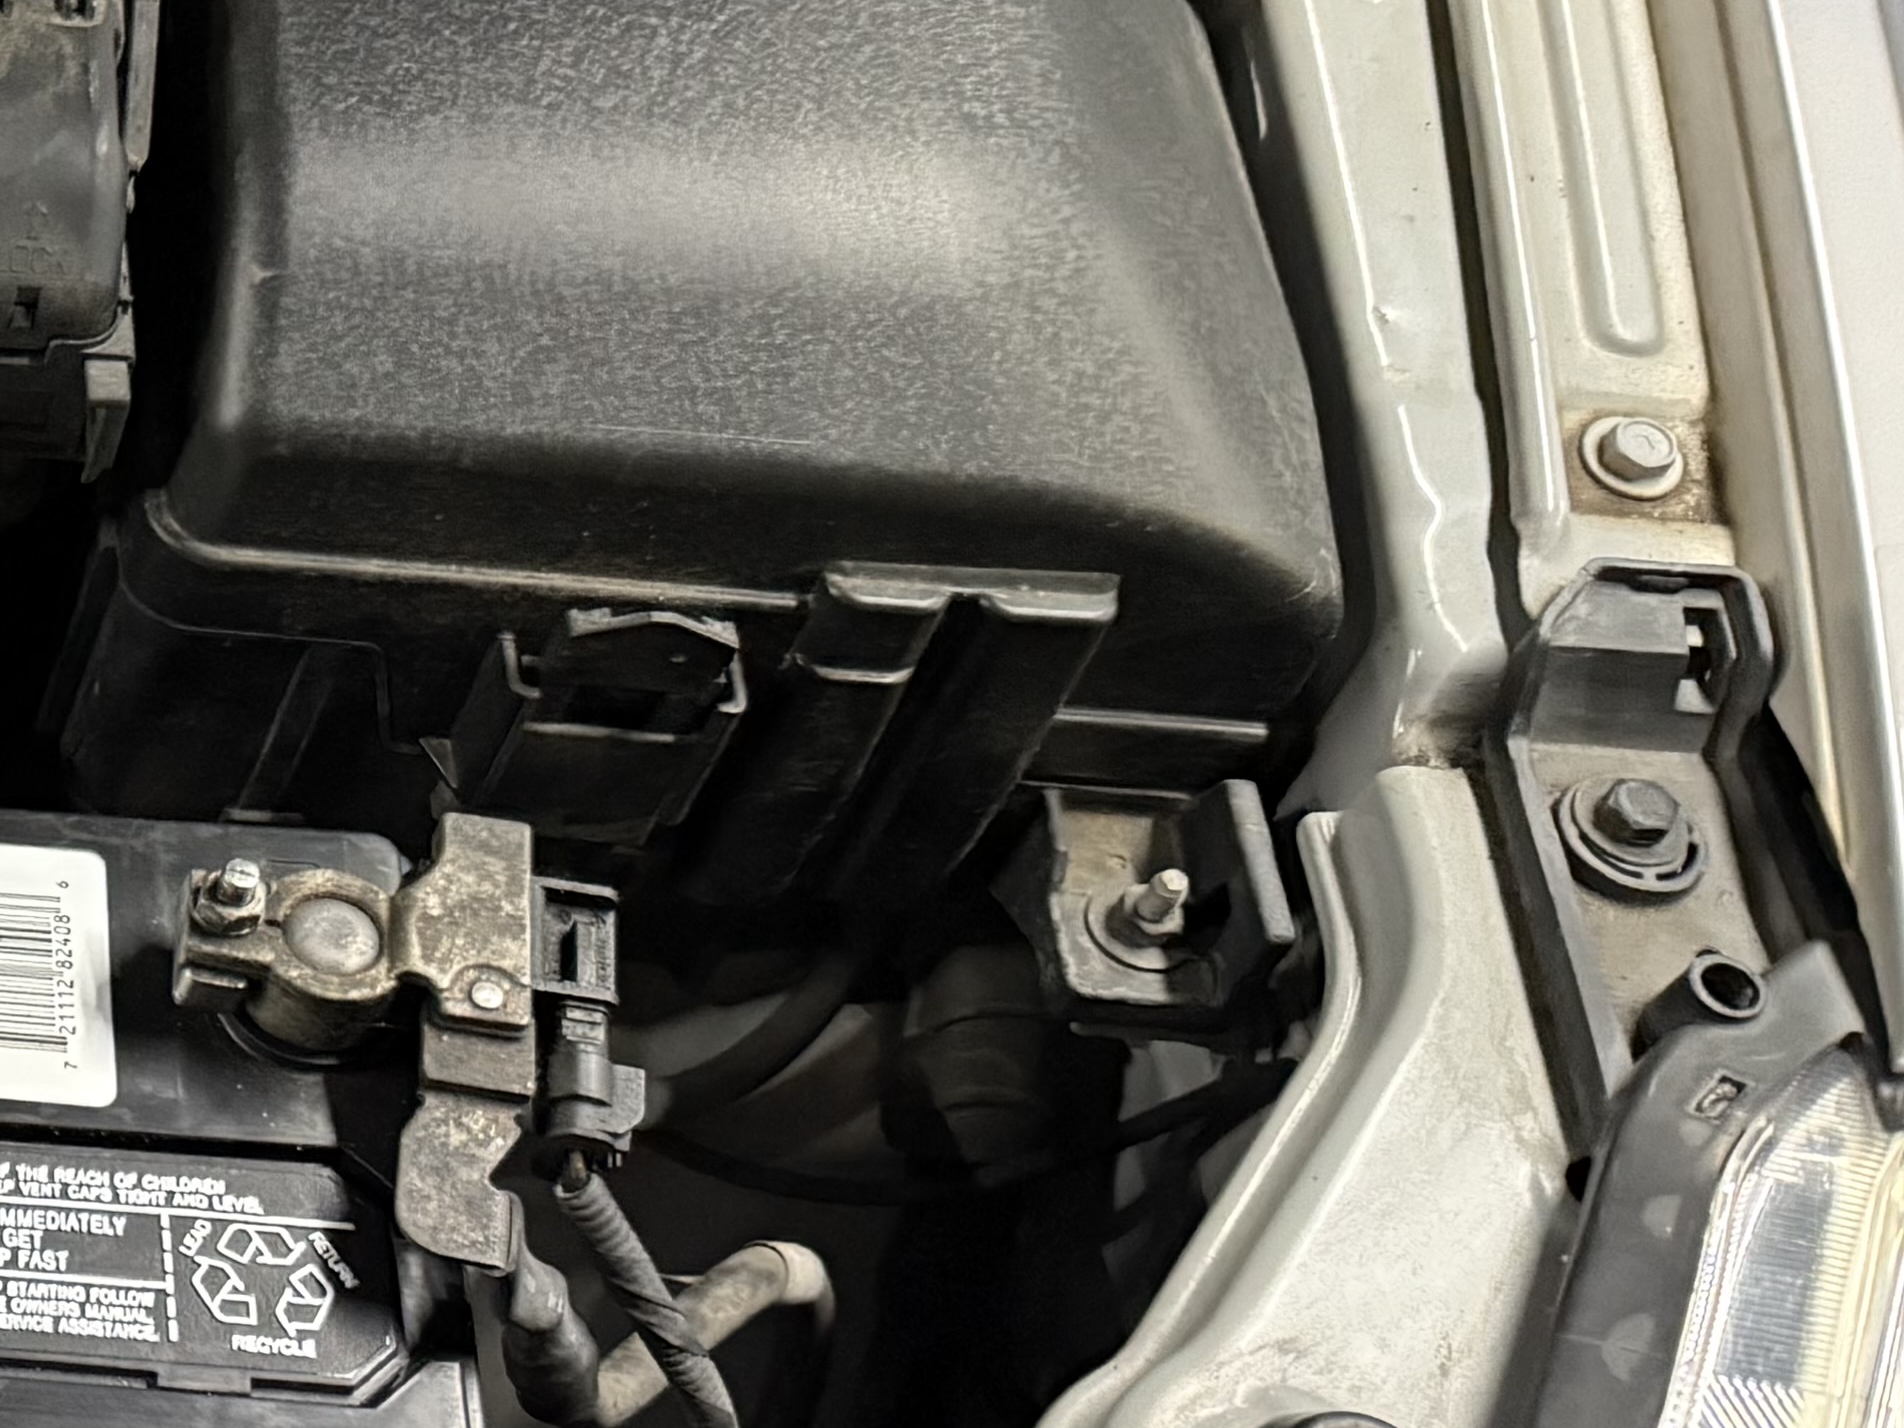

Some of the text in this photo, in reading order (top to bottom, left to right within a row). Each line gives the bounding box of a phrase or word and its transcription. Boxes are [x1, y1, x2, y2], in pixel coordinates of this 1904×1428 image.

[14, 1162, 50, 1184] THE
[52, 1165, 111, 1189] REACH
[113, 1170, 139, 1191] OF
[140, 1173, 227, 1197] CHILDREN
[17, 1179, 64, 1201] VENT
[66, 1183, 115, 1205] CAPS
[115, 1186, 168, 1209] TIGHT
[171, 1191, 210, 1212] AND
[1, 1227, 44, 1251] GET
[17, 1246, 70, 1272] FAST
[308, 1231, 360, 1289] RETURN
[5, 1280, 88, 1304] STARTING
[88, 1286, 156, 1308] FOLLOW
[231, 1334, 317, 1359] RECYCLE
